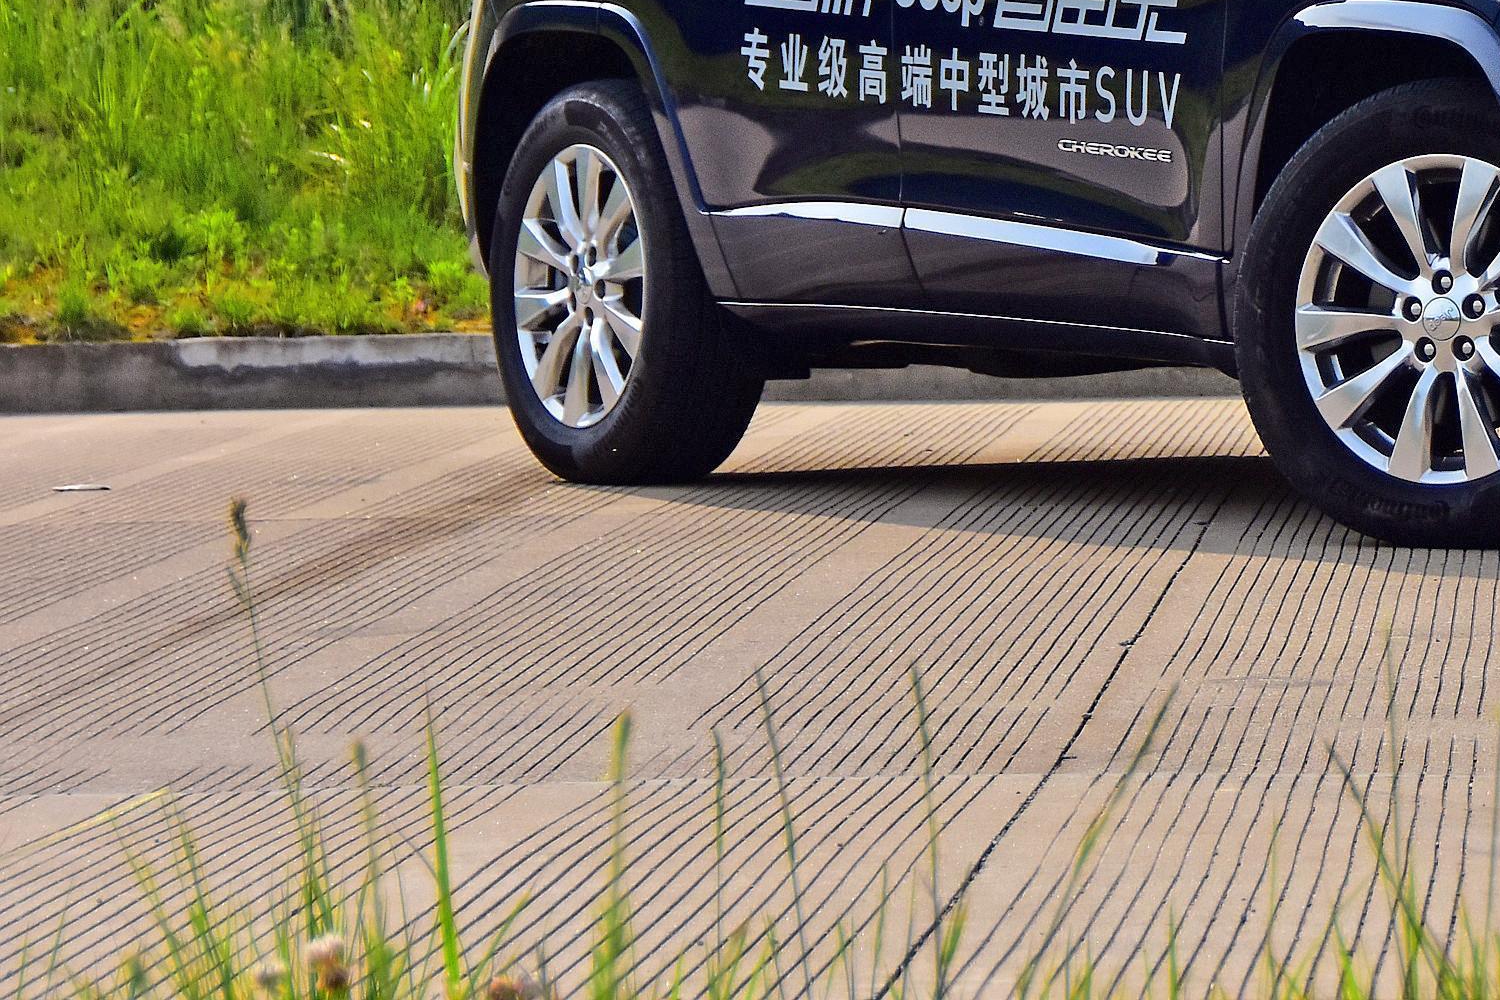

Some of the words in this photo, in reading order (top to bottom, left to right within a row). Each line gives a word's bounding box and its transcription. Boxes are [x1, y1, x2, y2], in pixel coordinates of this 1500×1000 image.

[740, 27, 1181, 130] 专业级高端中型城市SUV
[1057, 139, 1172, 163] CHEROKEE
